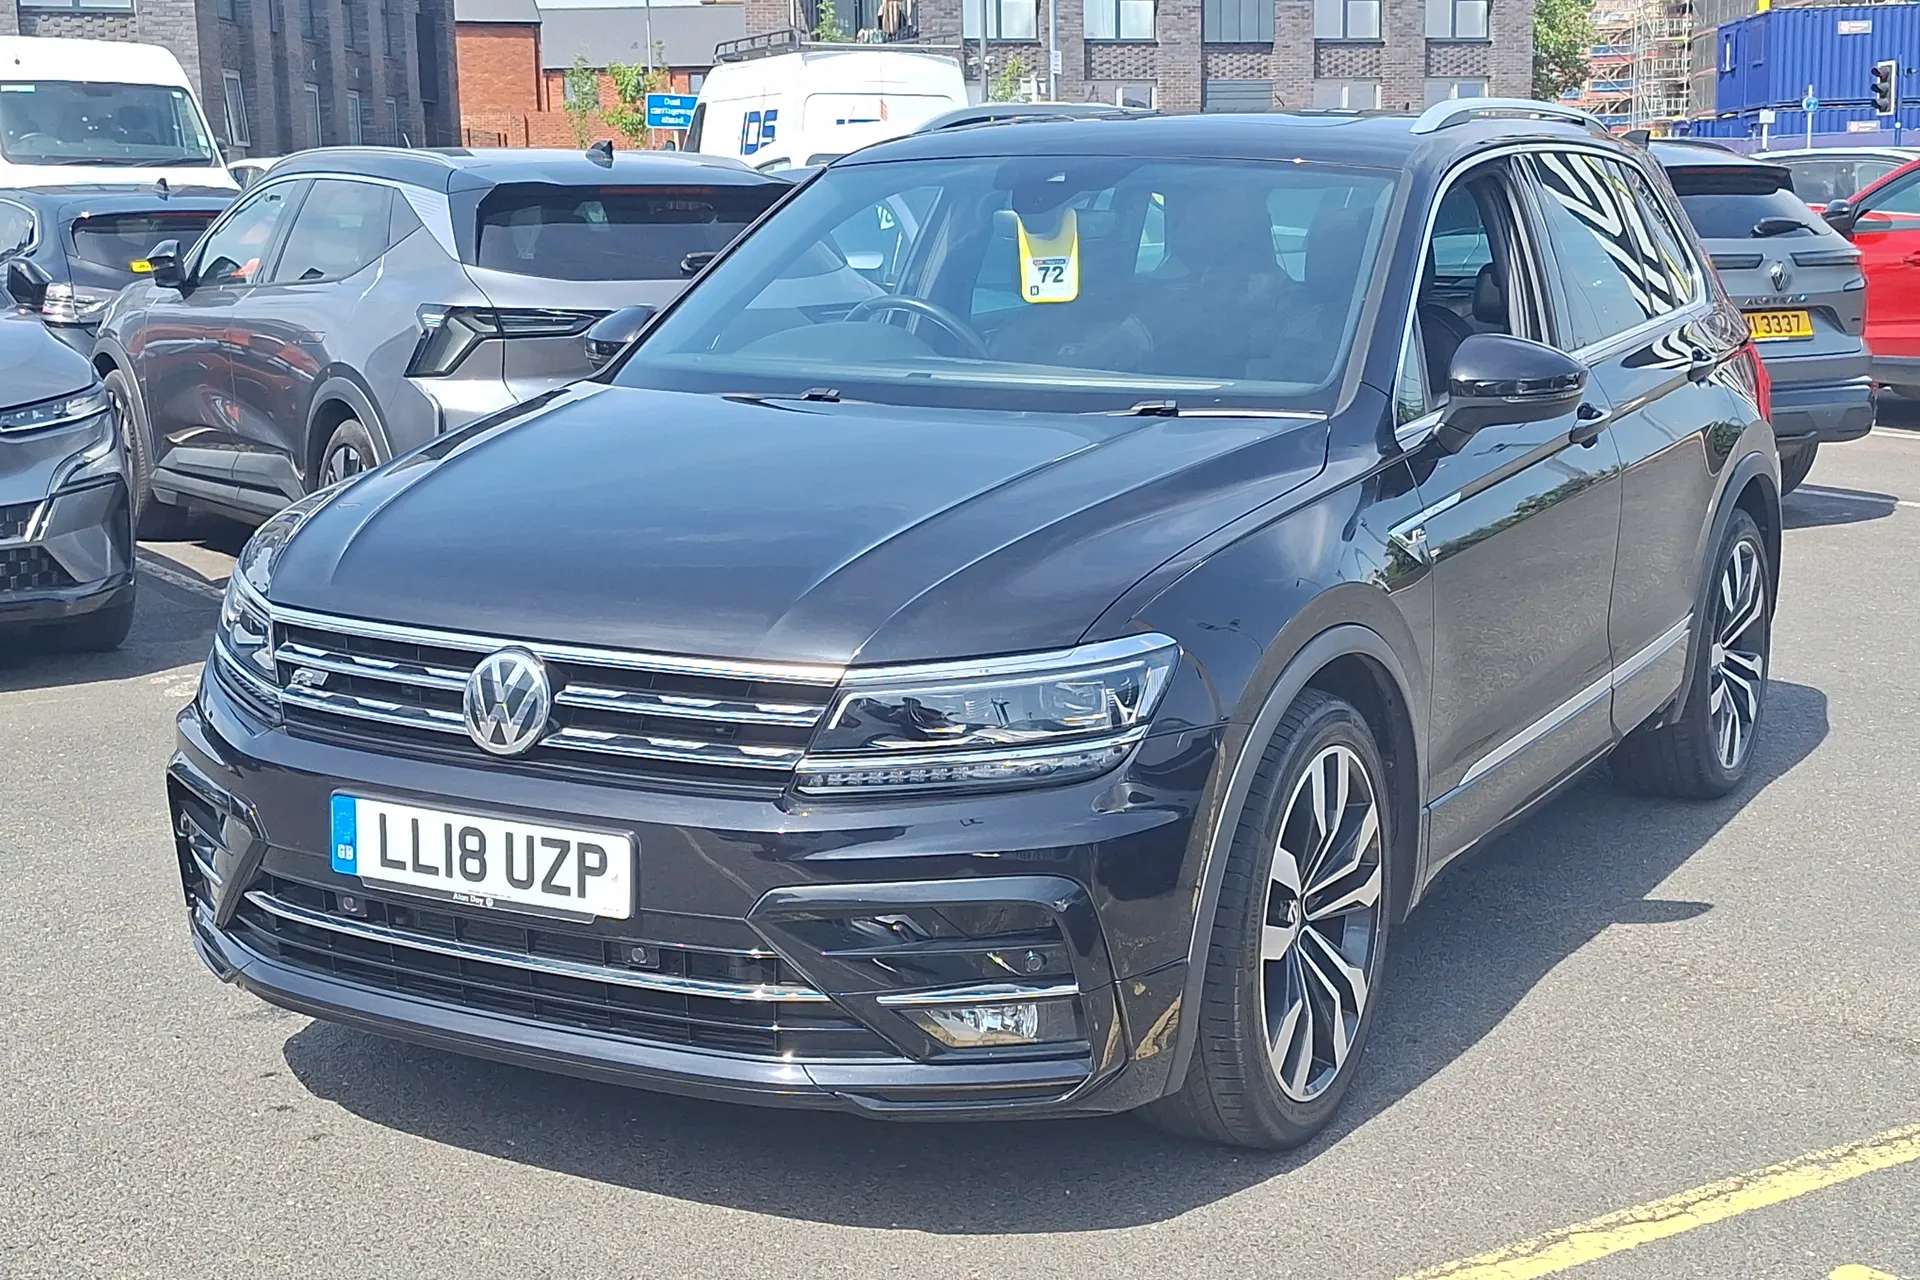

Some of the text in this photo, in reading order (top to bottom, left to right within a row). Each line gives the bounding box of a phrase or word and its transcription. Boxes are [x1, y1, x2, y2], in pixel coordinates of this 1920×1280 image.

[1037, 266, 1064, 283] 72
[1761, 314, 1800, 334] 3337
[337, 844, 354, 860] GB
[379, 812, 608, 899] LL18 UZP
